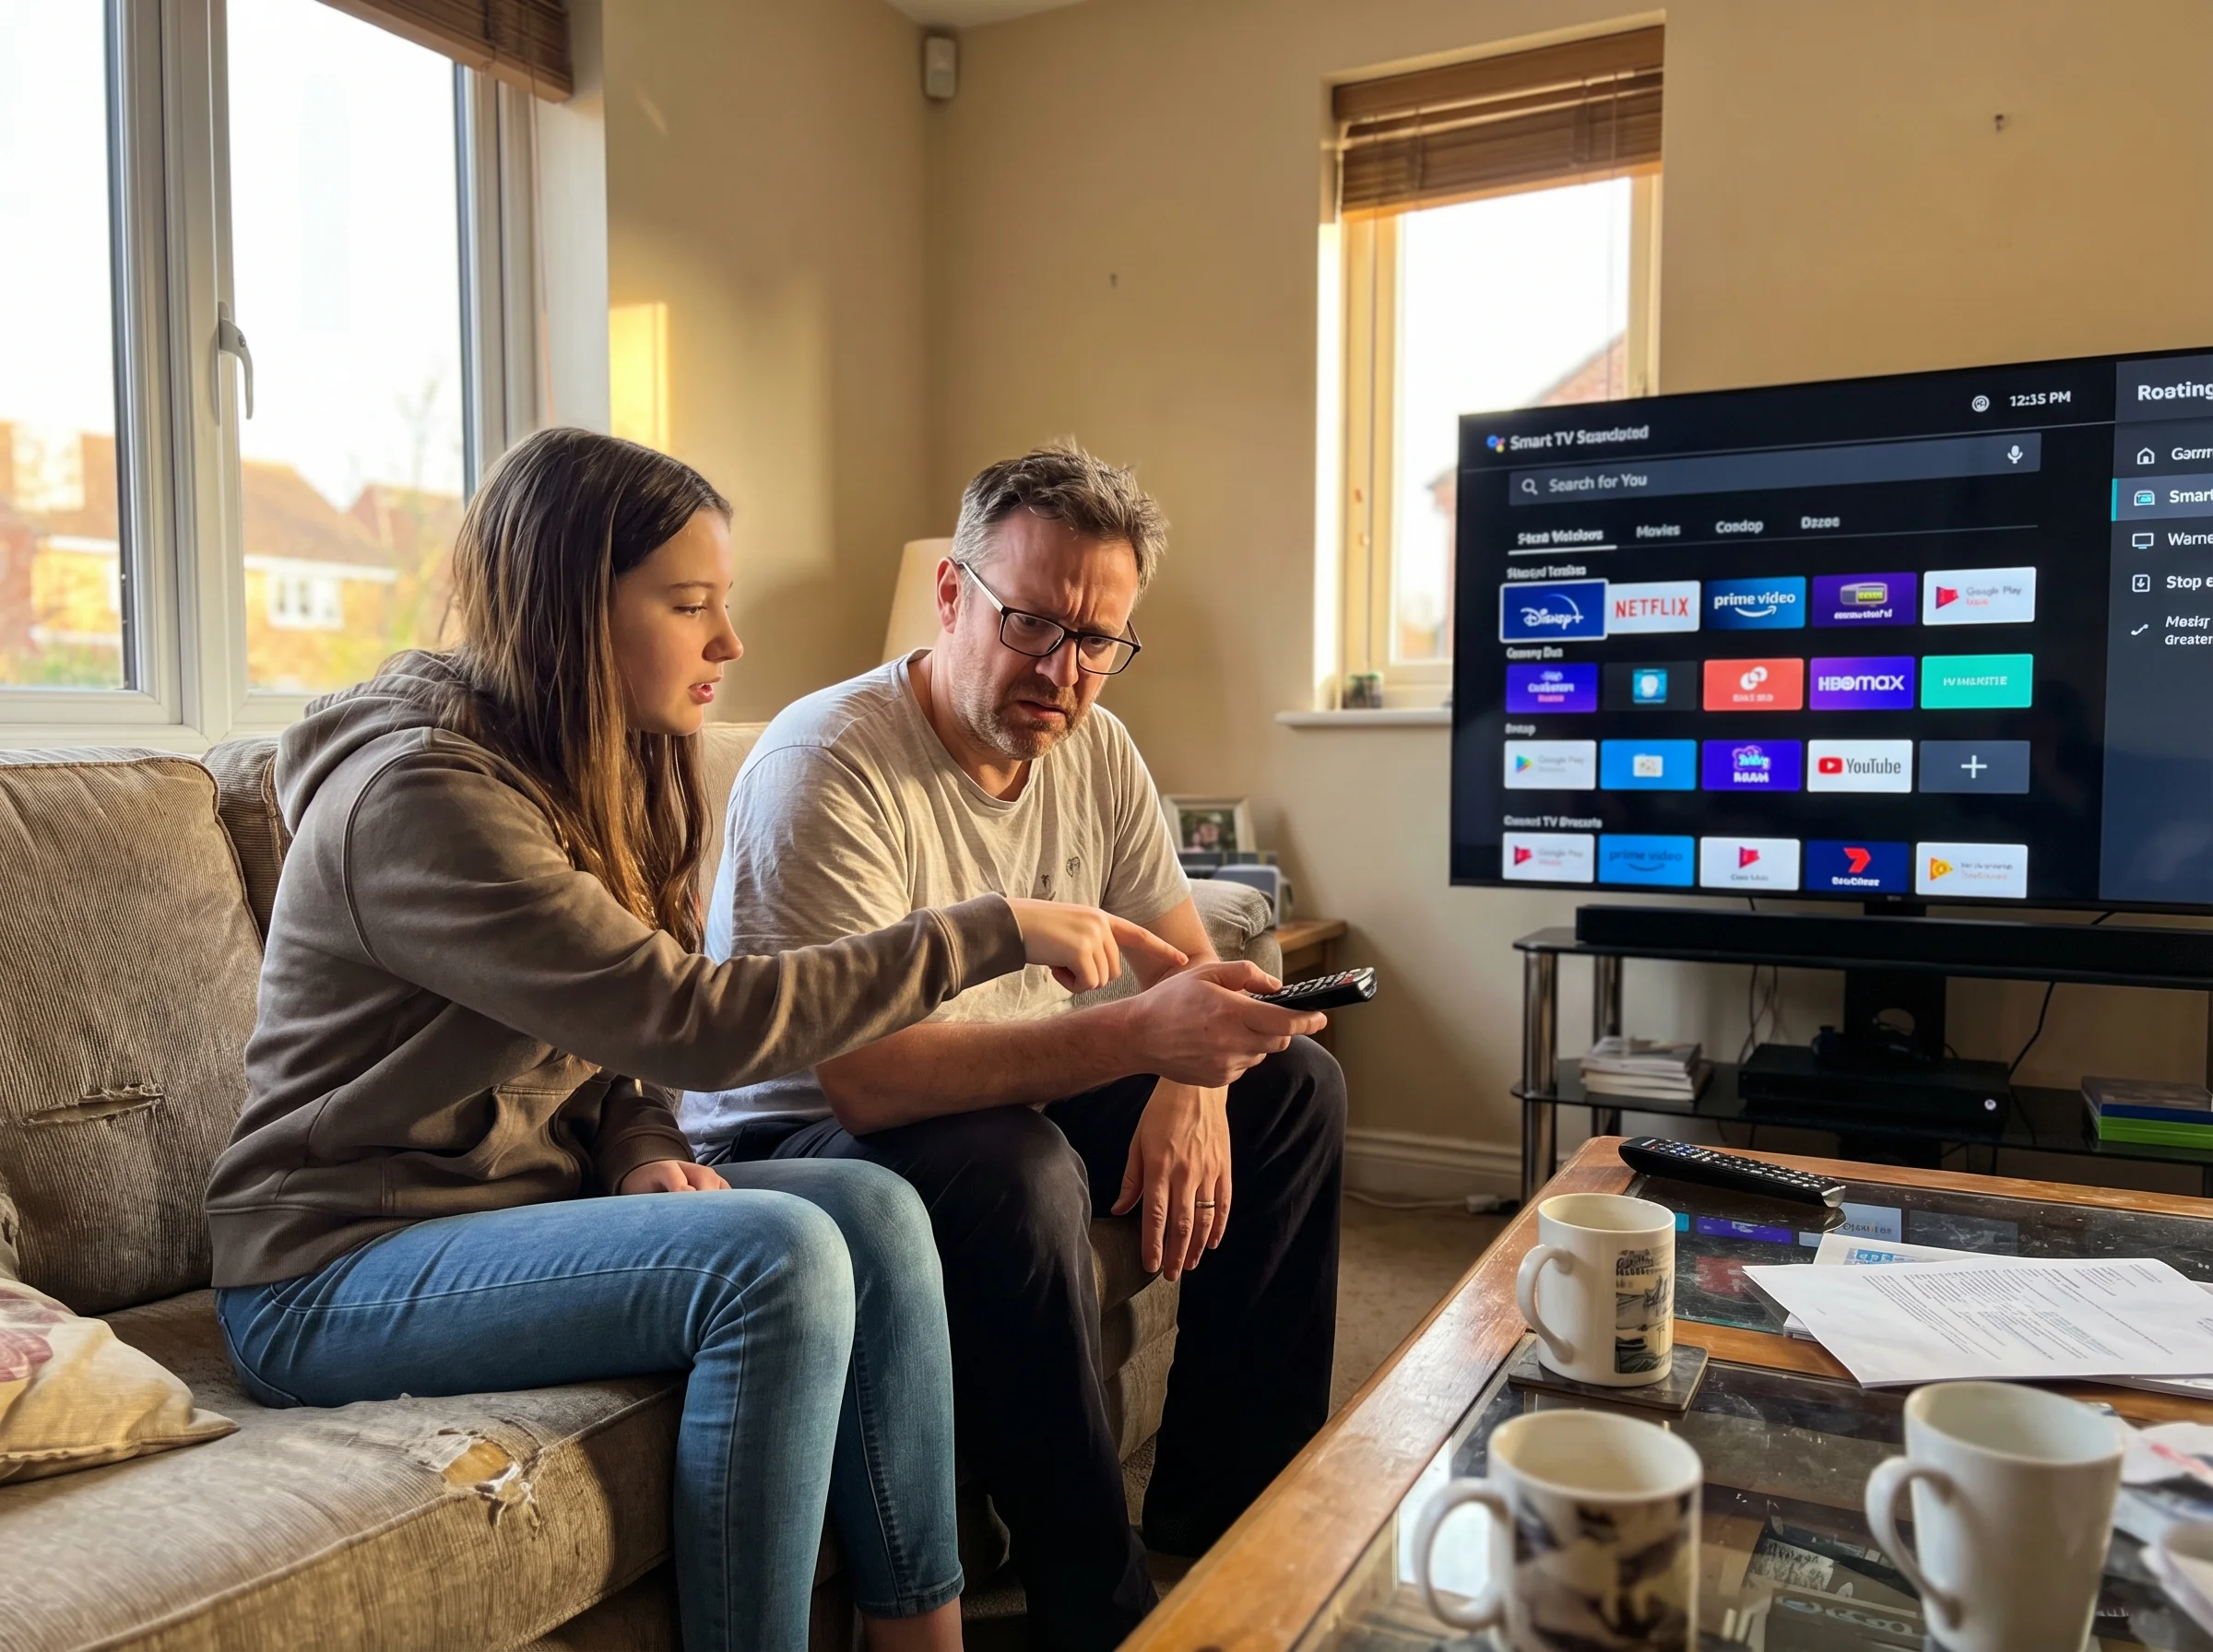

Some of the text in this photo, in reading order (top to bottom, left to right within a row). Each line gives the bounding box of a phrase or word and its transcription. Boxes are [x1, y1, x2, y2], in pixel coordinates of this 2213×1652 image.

[2049, 391, 2072, 404] PM
[1510, 433, 1552, 450] Smart
[1555, 431, 1574, 445] TV
[1549, 474, 1648, 492] Search for You
[1636, 524, 1681, 538] Movies
[2166, 575, 2202, 591] Stop
[1615, 597, 1689, 619] NETFLIX
[1713, 591, 1796, 609] prime video
[1846, 758, 1901, 775] YouTube
[1609, 849, 1683, 862] prime video
